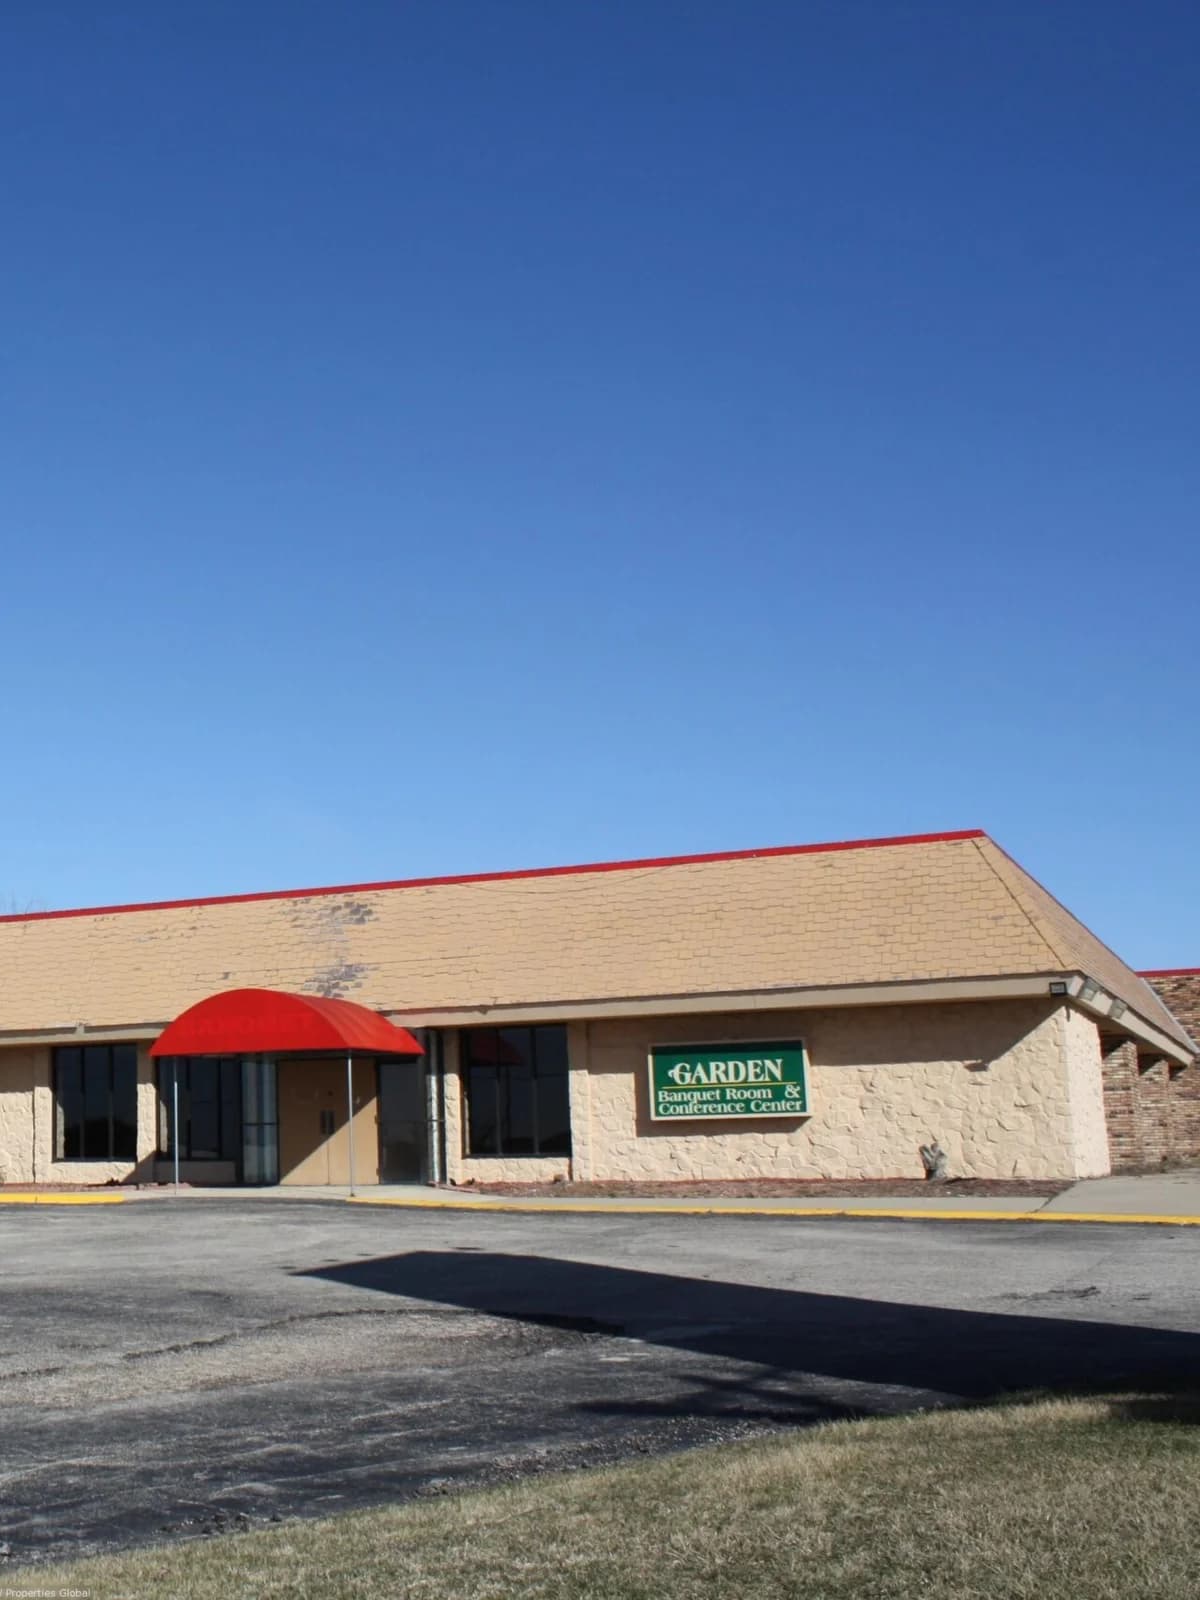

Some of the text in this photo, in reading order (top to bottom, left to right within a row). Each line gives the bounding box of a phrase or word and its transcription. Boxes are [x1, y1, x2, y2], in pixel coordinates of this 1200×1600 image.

[668, 1059, 783, 1085] GARDEN
[658, 1085, 800, 1104] Banquet Room &
[658, 1100, 802, 1115] Conference Center
